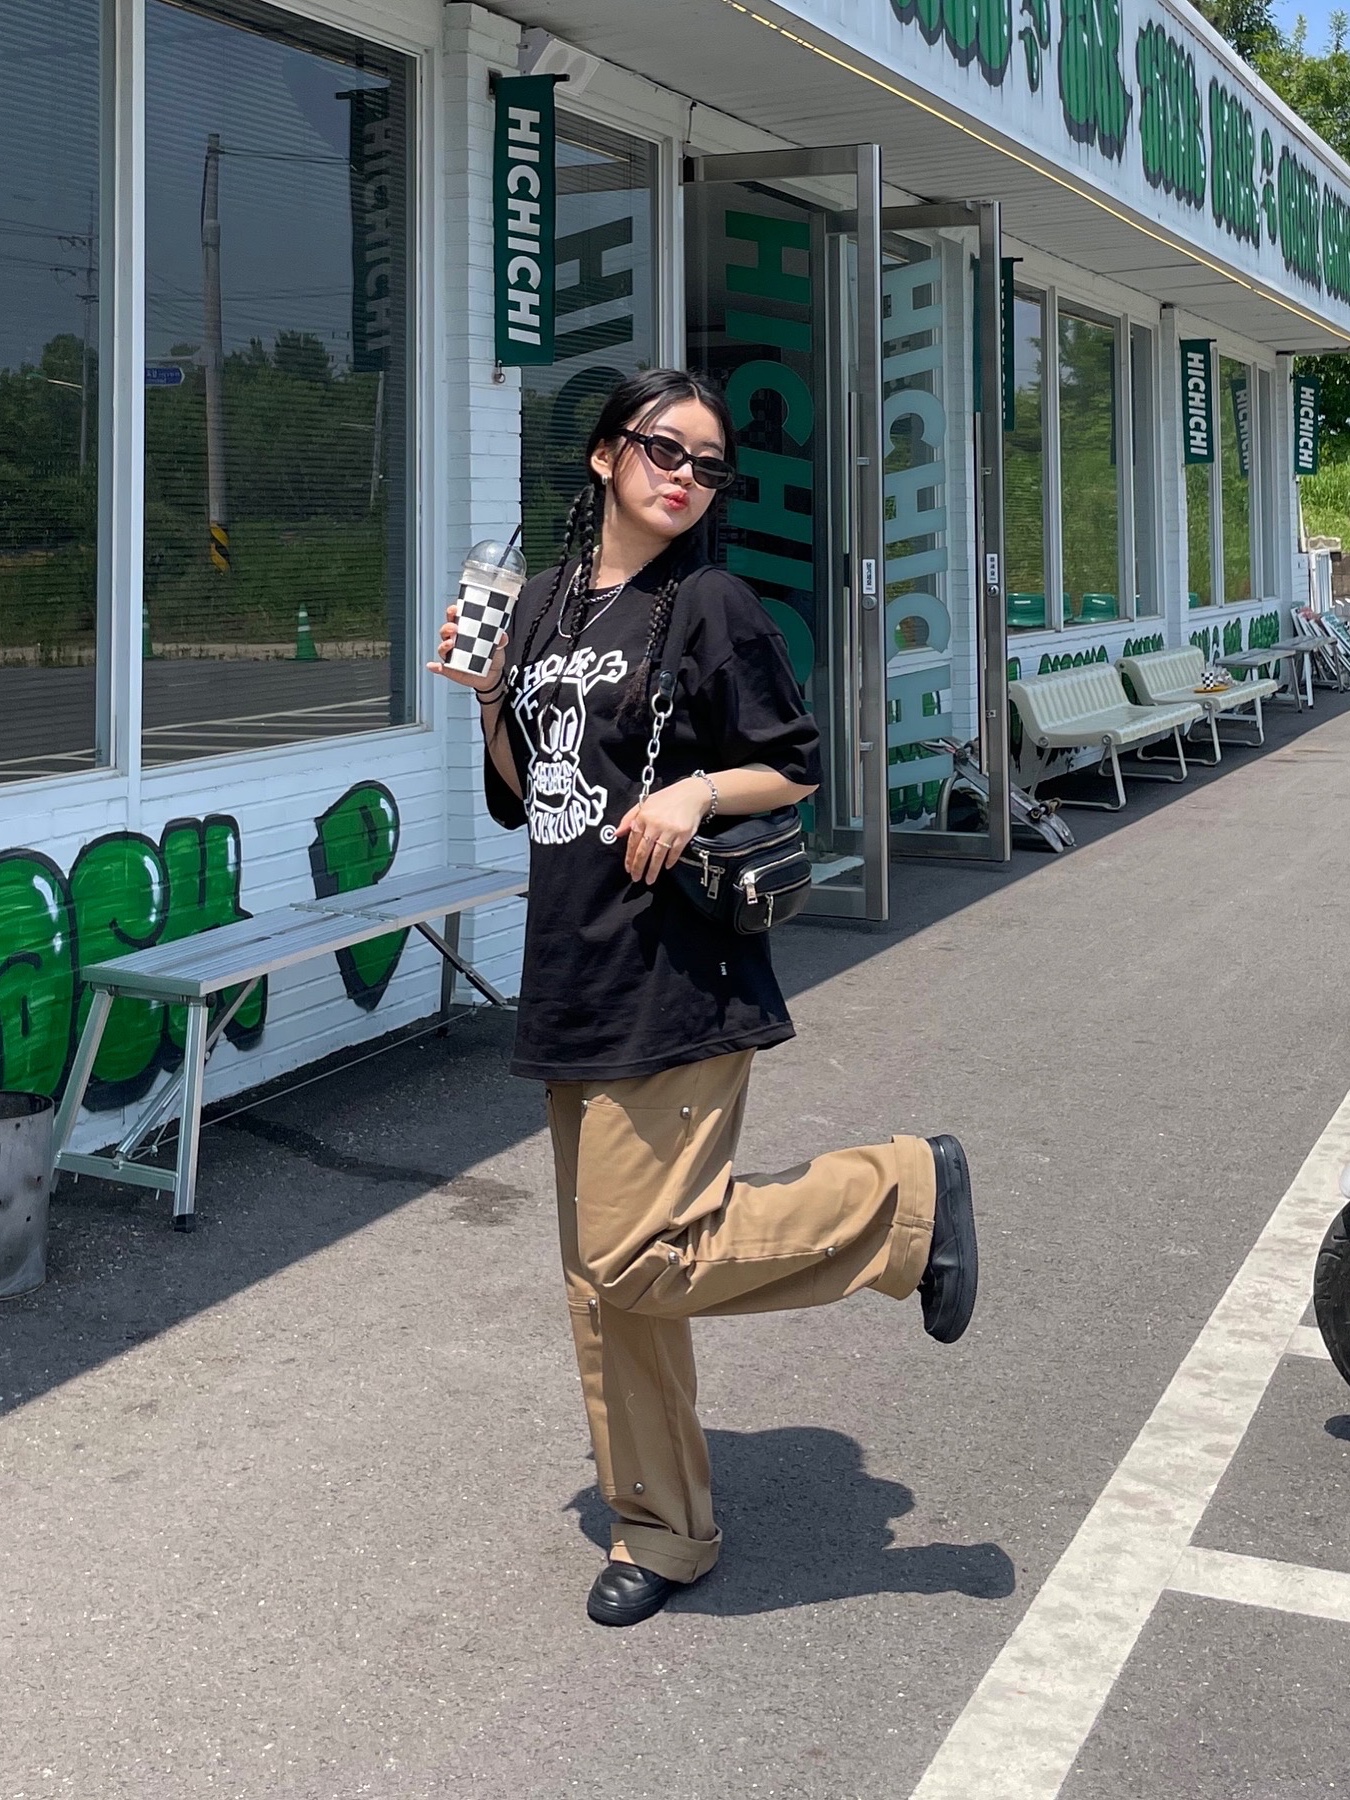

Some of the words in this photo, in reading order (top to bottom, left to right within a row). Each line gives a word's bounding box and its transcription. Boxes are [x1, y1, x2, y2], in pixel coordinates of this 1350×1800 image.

[507, 106, 541, 345] HICHICHI
[1187, 351, 1208, 455] HICHICHI
[1299, 386, 1315, 469] HICHICHI
[883, 257, 952, 788] HICHICHI
